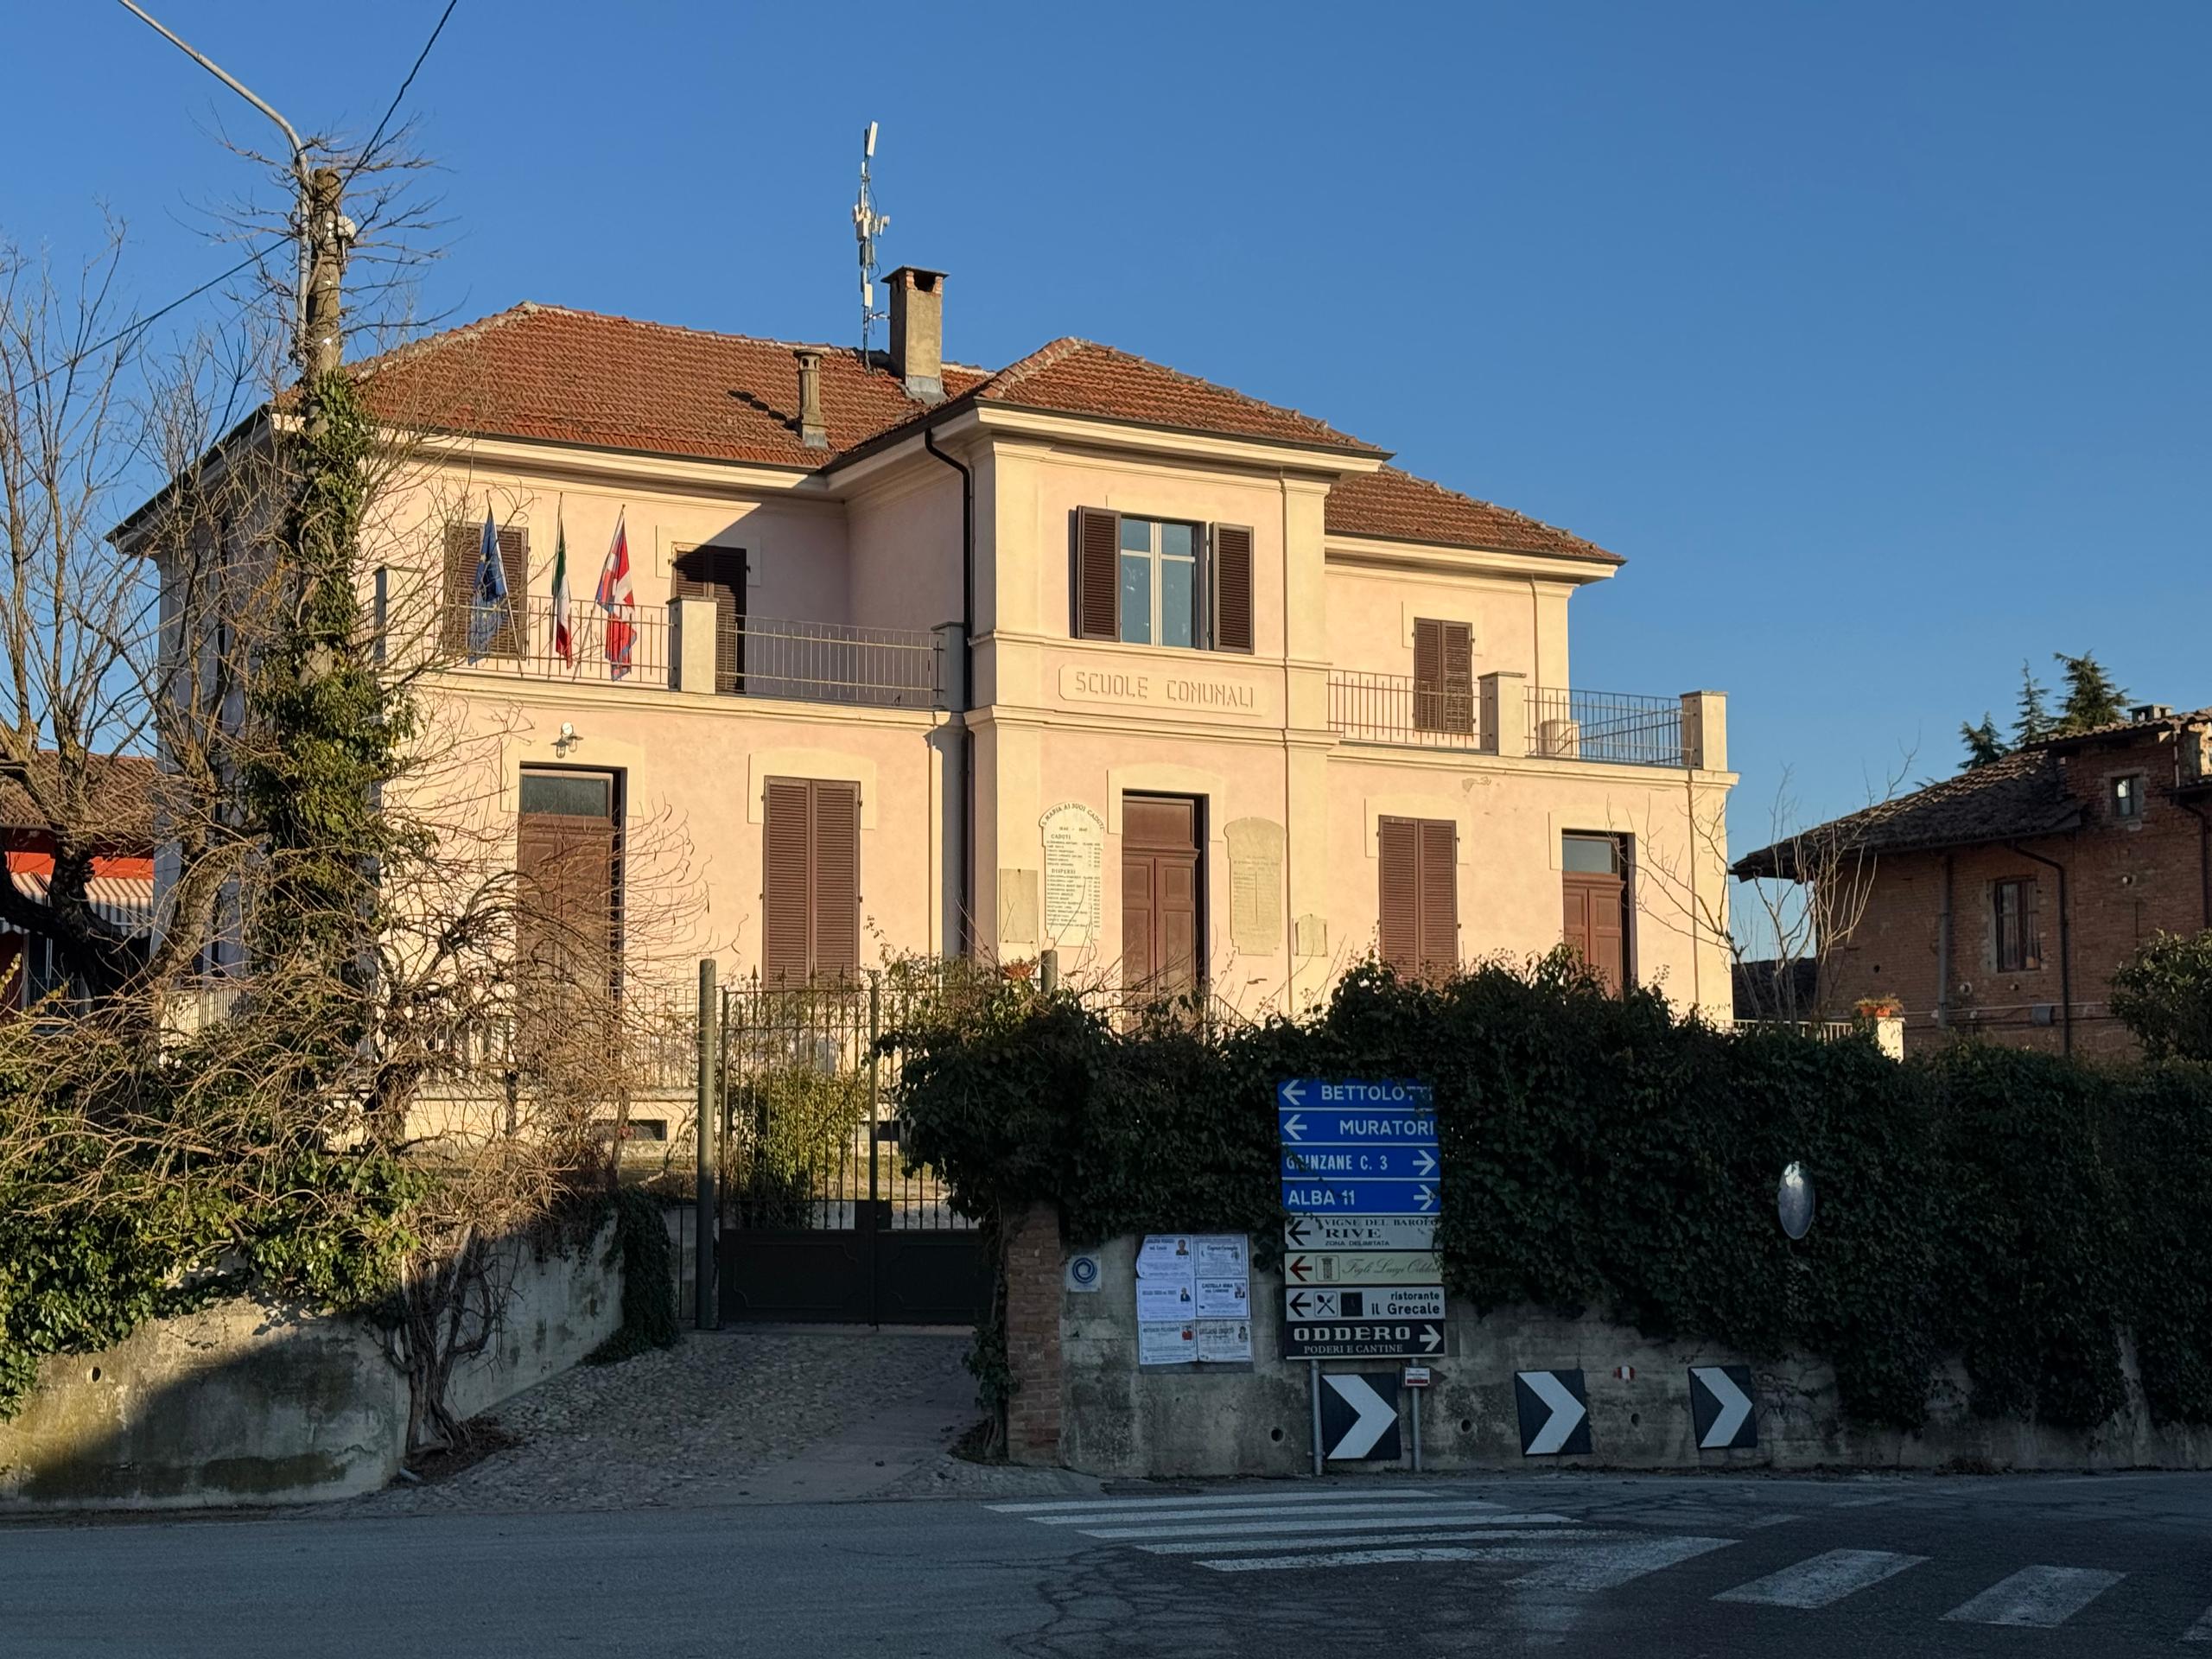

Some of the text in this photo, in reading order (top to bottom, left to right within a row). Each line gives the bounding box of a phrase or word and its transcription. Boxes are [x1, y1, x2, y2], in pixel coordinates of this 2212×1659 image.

[1075, 671, 1254, 709] SCUOLE COMUNALI
[1339, 1120, 1434, 1135] MURATORI
[1360, 1155, 1372, 1170] C.
[1380, 1155, 1388, 1170] 3
[1287, 1190, 1355, 1205] ALBA 11
[1325, 1228, 1382, 1238] RIVE
[1390, 1292, 1440, 1300] ristorante
[1372, 1303, 1440, 1315] il Grecale
[1294, 1327, 1411, 1341] ODDERO
[1304, 1344, 1403, 1354] PODERI E CANTINE
